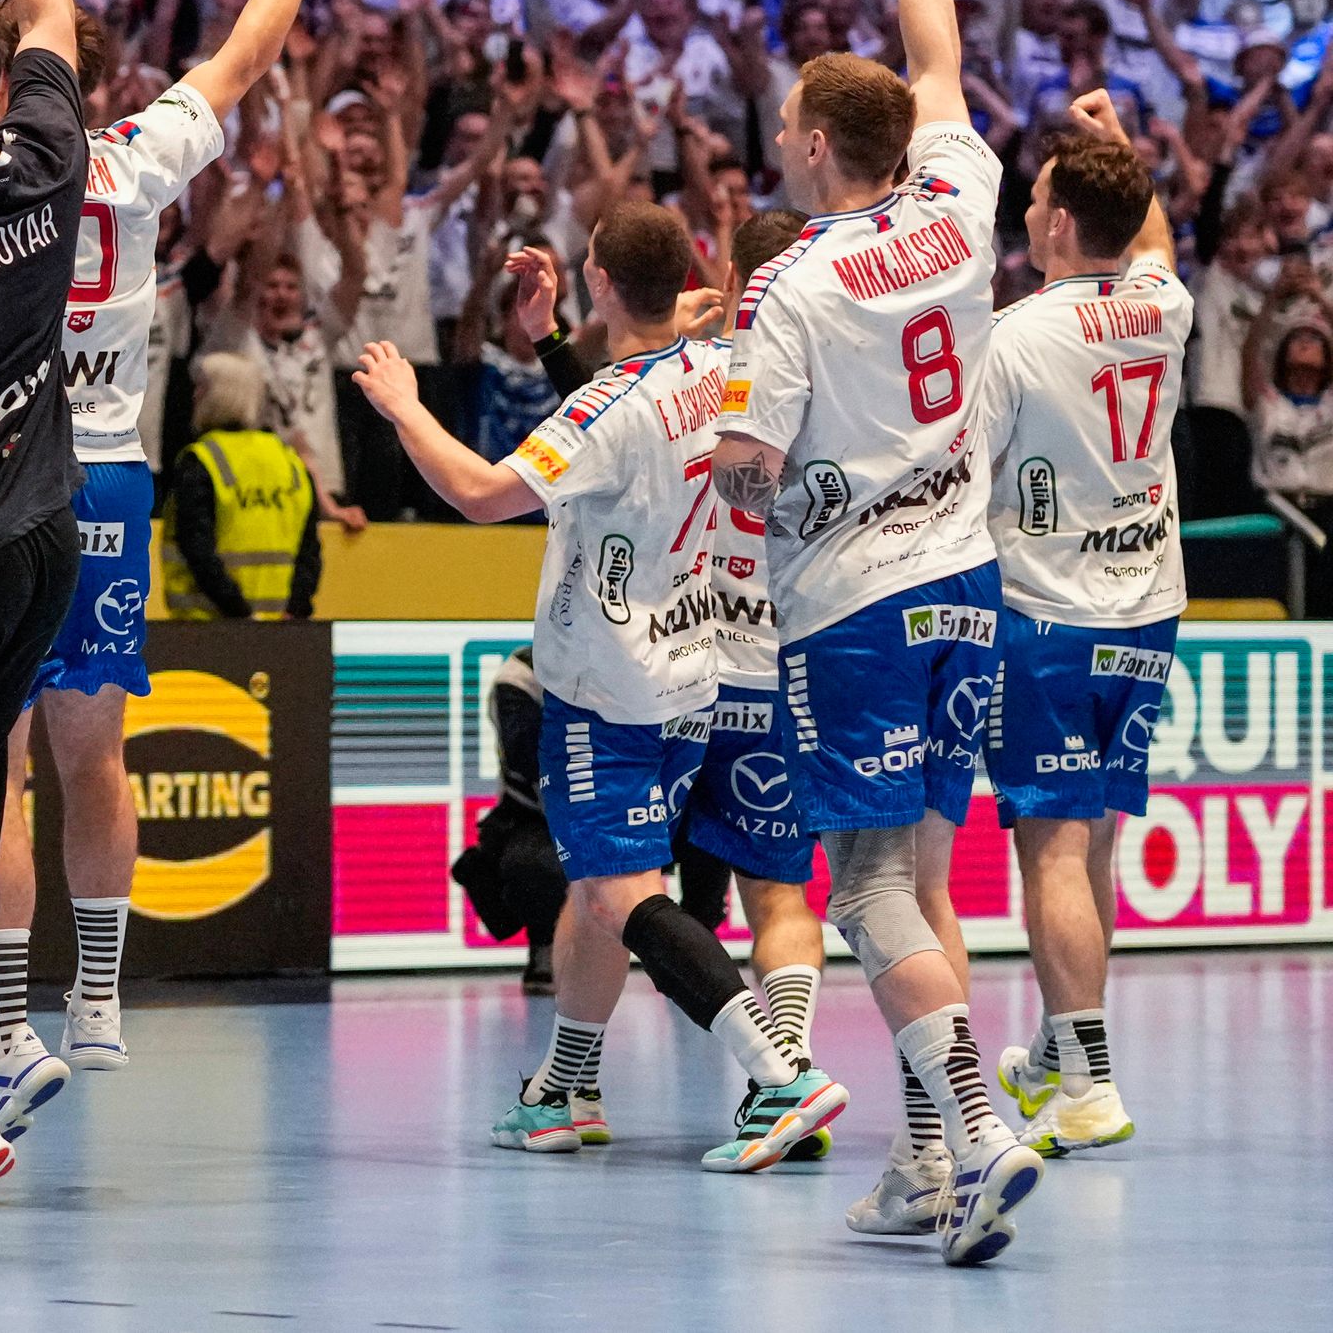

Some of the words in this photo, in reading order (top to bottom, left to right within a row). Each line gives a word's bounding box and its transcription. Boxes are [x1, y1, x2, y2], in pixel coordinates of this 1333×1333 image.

[831, 214, 973, 303] MIKKJALSSON
[71, 314, 92, 326] 24
[901, 304, 963, 425] 8
[1091, 354, 1167, 464] 17
[1030, 467, 1051, 530] Silikal
[1113, 492, 1147, 508] SPORT
[606, 545, 628, 608] Silikal
[732, 560, 752, 574] 24
[1035, 620, 1053, 635] 17
[721, 809, 800, 839] AZDA
